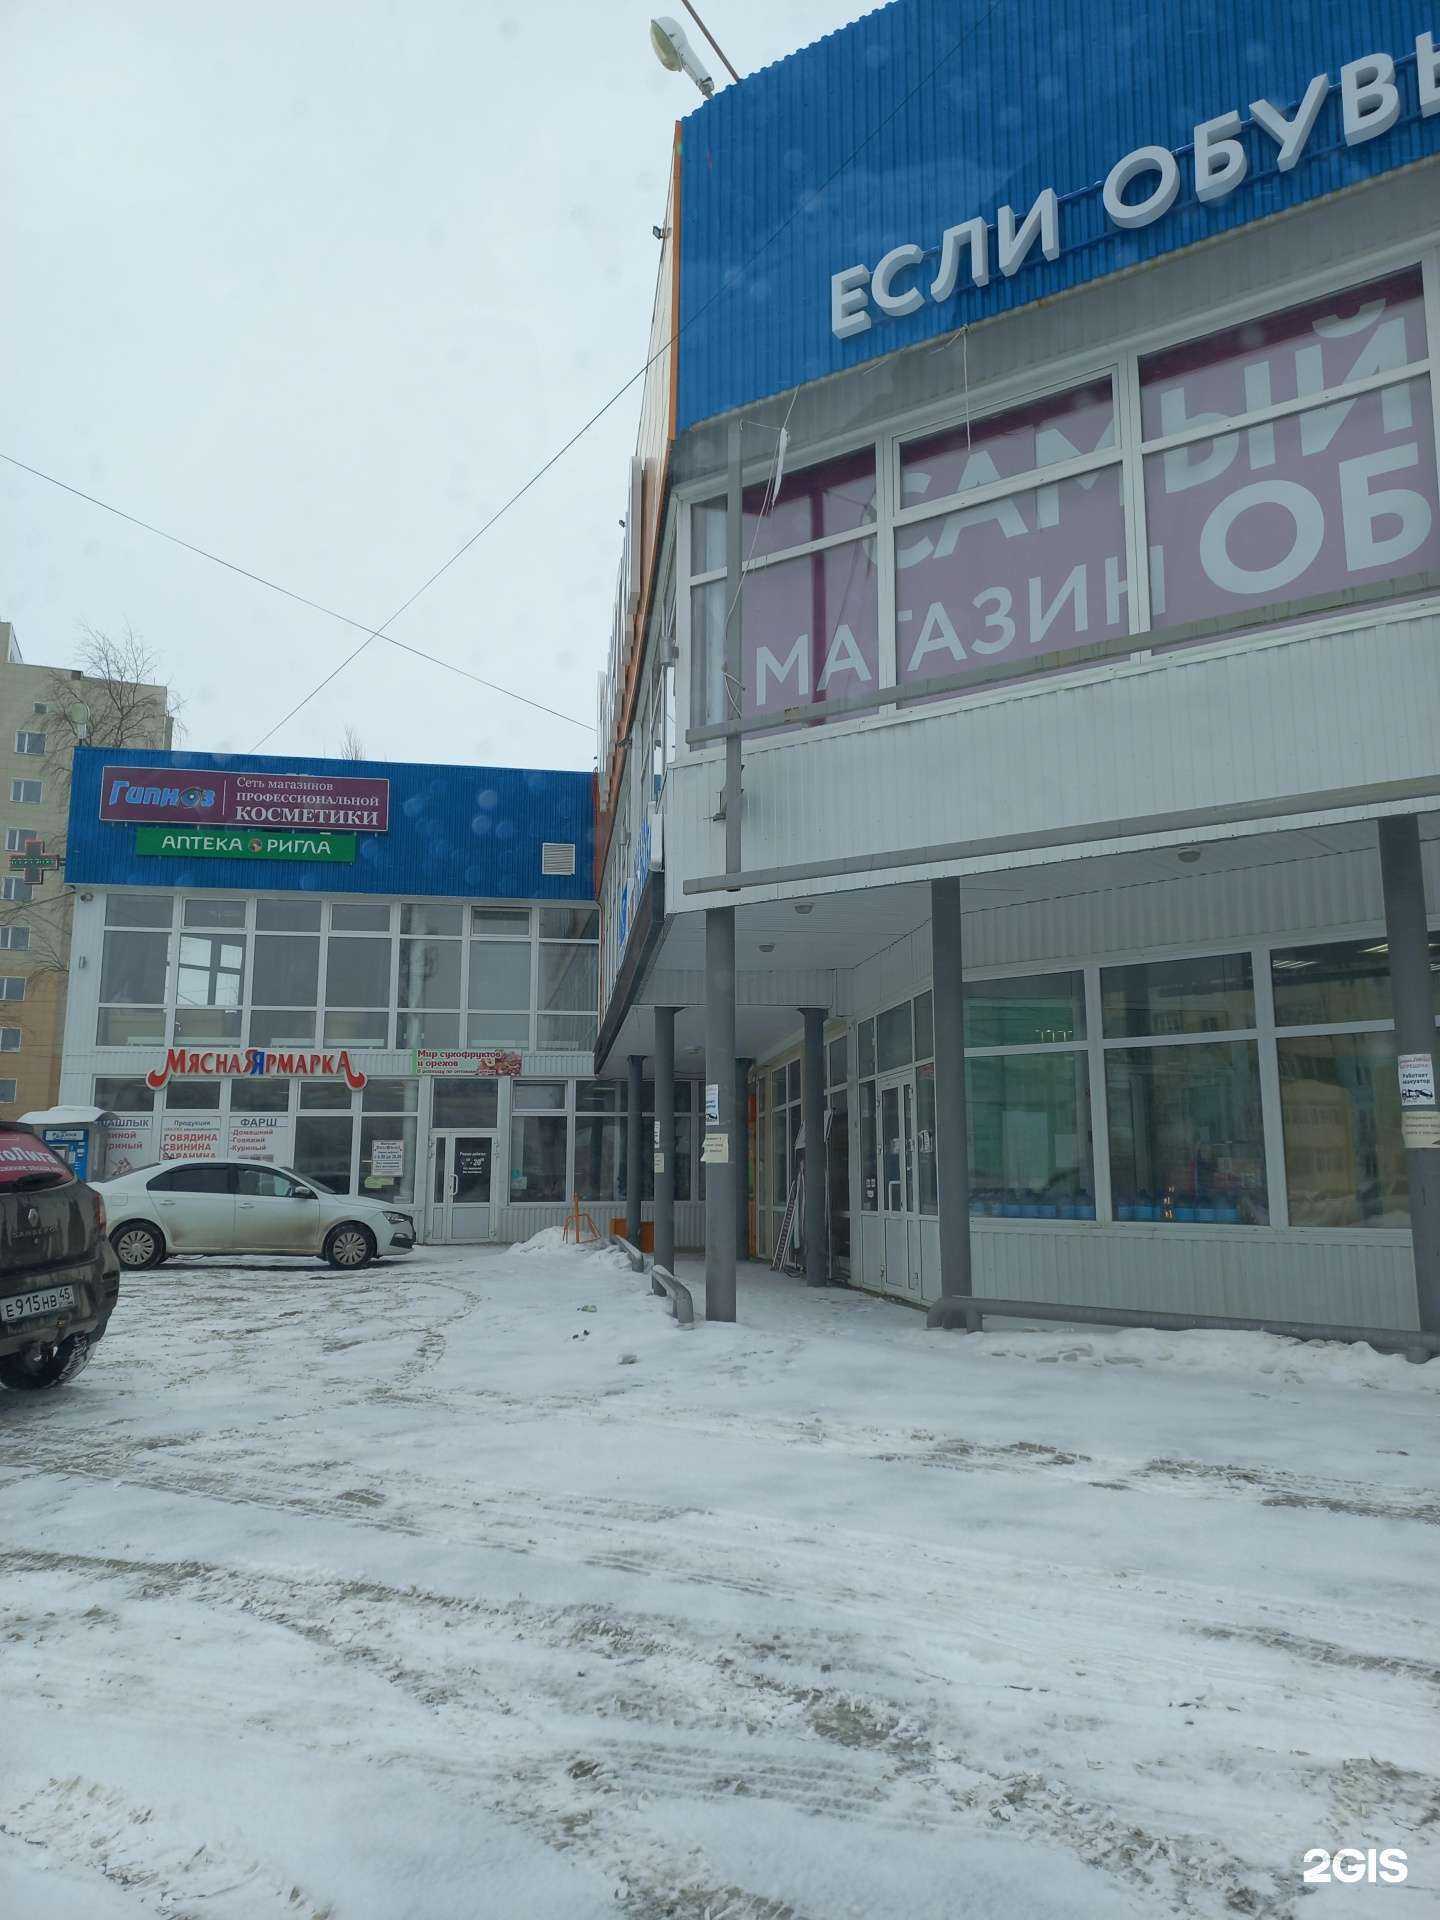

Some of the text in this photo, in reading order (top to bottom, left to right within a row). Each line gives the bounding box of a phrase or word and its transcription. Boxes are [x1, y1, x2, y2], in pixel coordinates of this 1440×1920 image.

[832, 187, 1060, 339] ЕСЛИ
[864, 299, 1414, 569] САМЫЙ
[756, 545, 1165, 705] МААЗИН
[237, 776, 333, 791] Сеть магазинов
[109, 780, 216, 808] Гипноз
[236, 792, 379, 806] ПРОФЕССИОНАЛЬНОЙ
[236, 806, 378, 826] КОСМЕТИКИ
[162, 835, 331, 854] АПТЕКА РИГЛА
[417, 1050, 501, 1059] Мир сухофруктов
[240, 1118, 277, 1127] ФАРШ
[164, 1134, 218, 1142] ГОВЯДИНА
[163, 1143, 211, 1151] СВИНИНА
